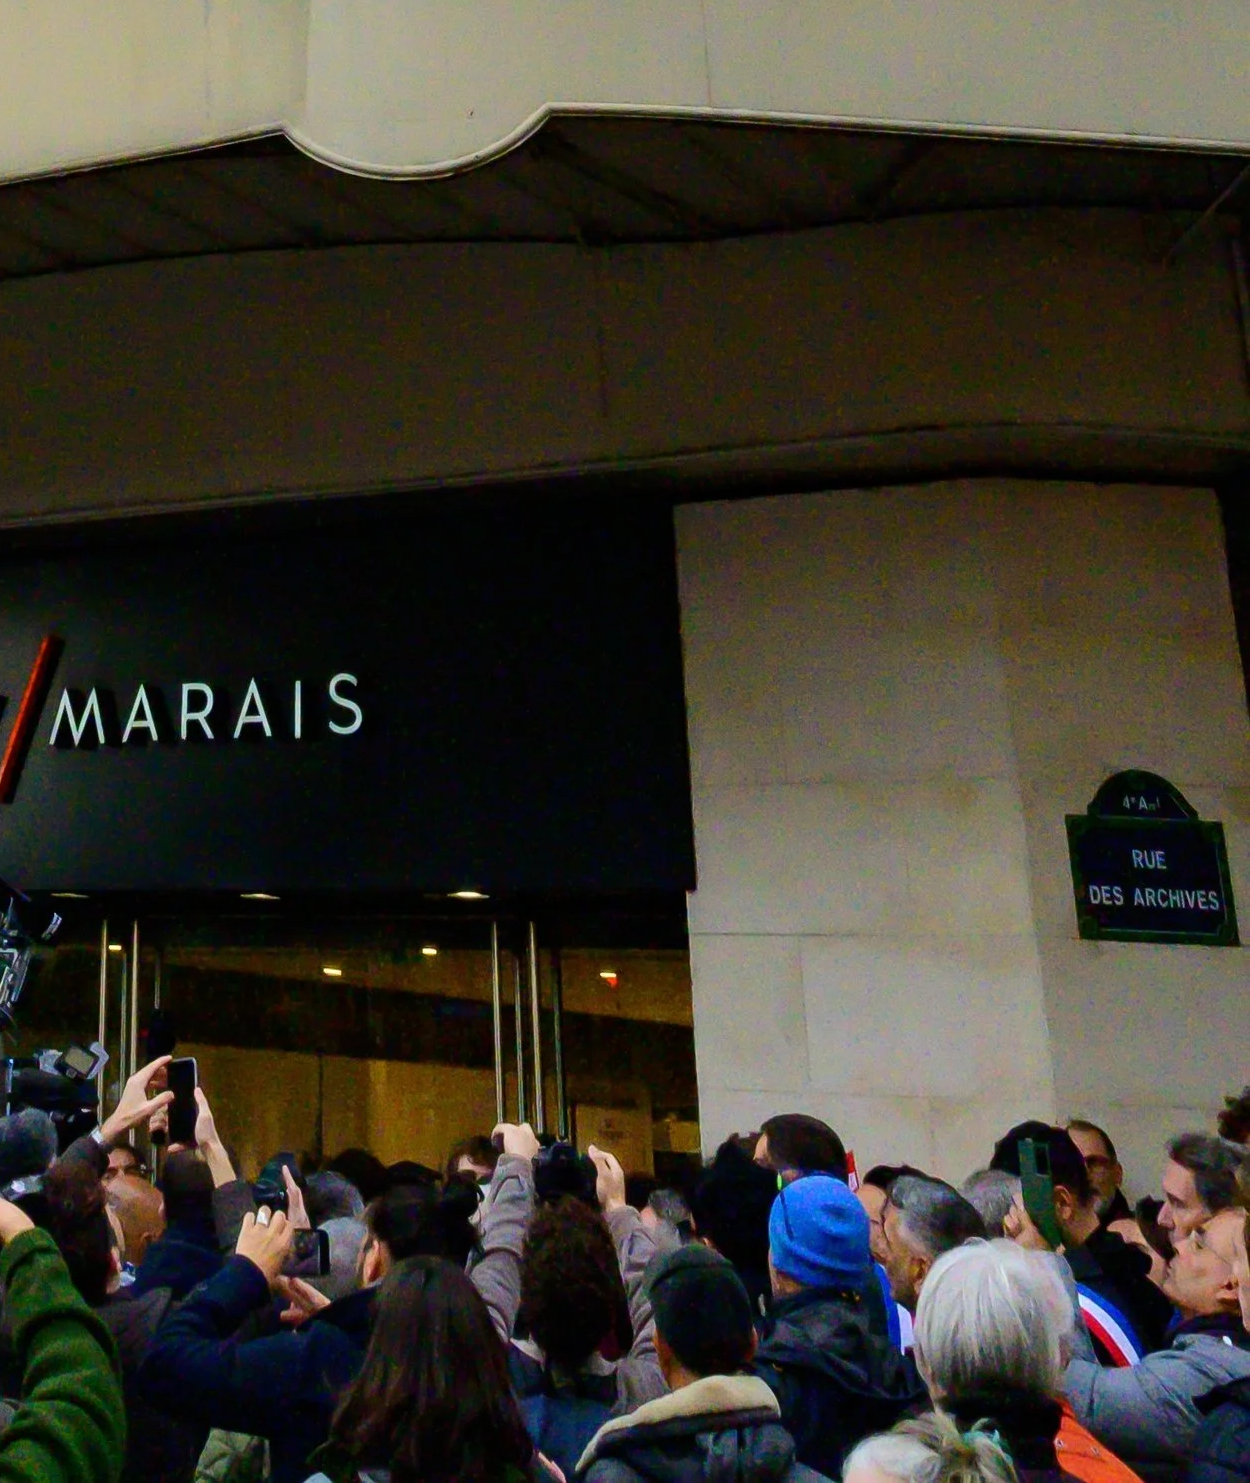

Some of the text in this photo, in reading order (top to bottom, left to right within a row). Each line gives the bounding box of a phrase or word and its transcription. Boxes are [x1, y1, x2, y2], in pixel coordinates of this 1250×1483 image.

[1132, 849, 1167, 870] RUE
[1089, 885, 1219, 911] DES ARCHIVES
